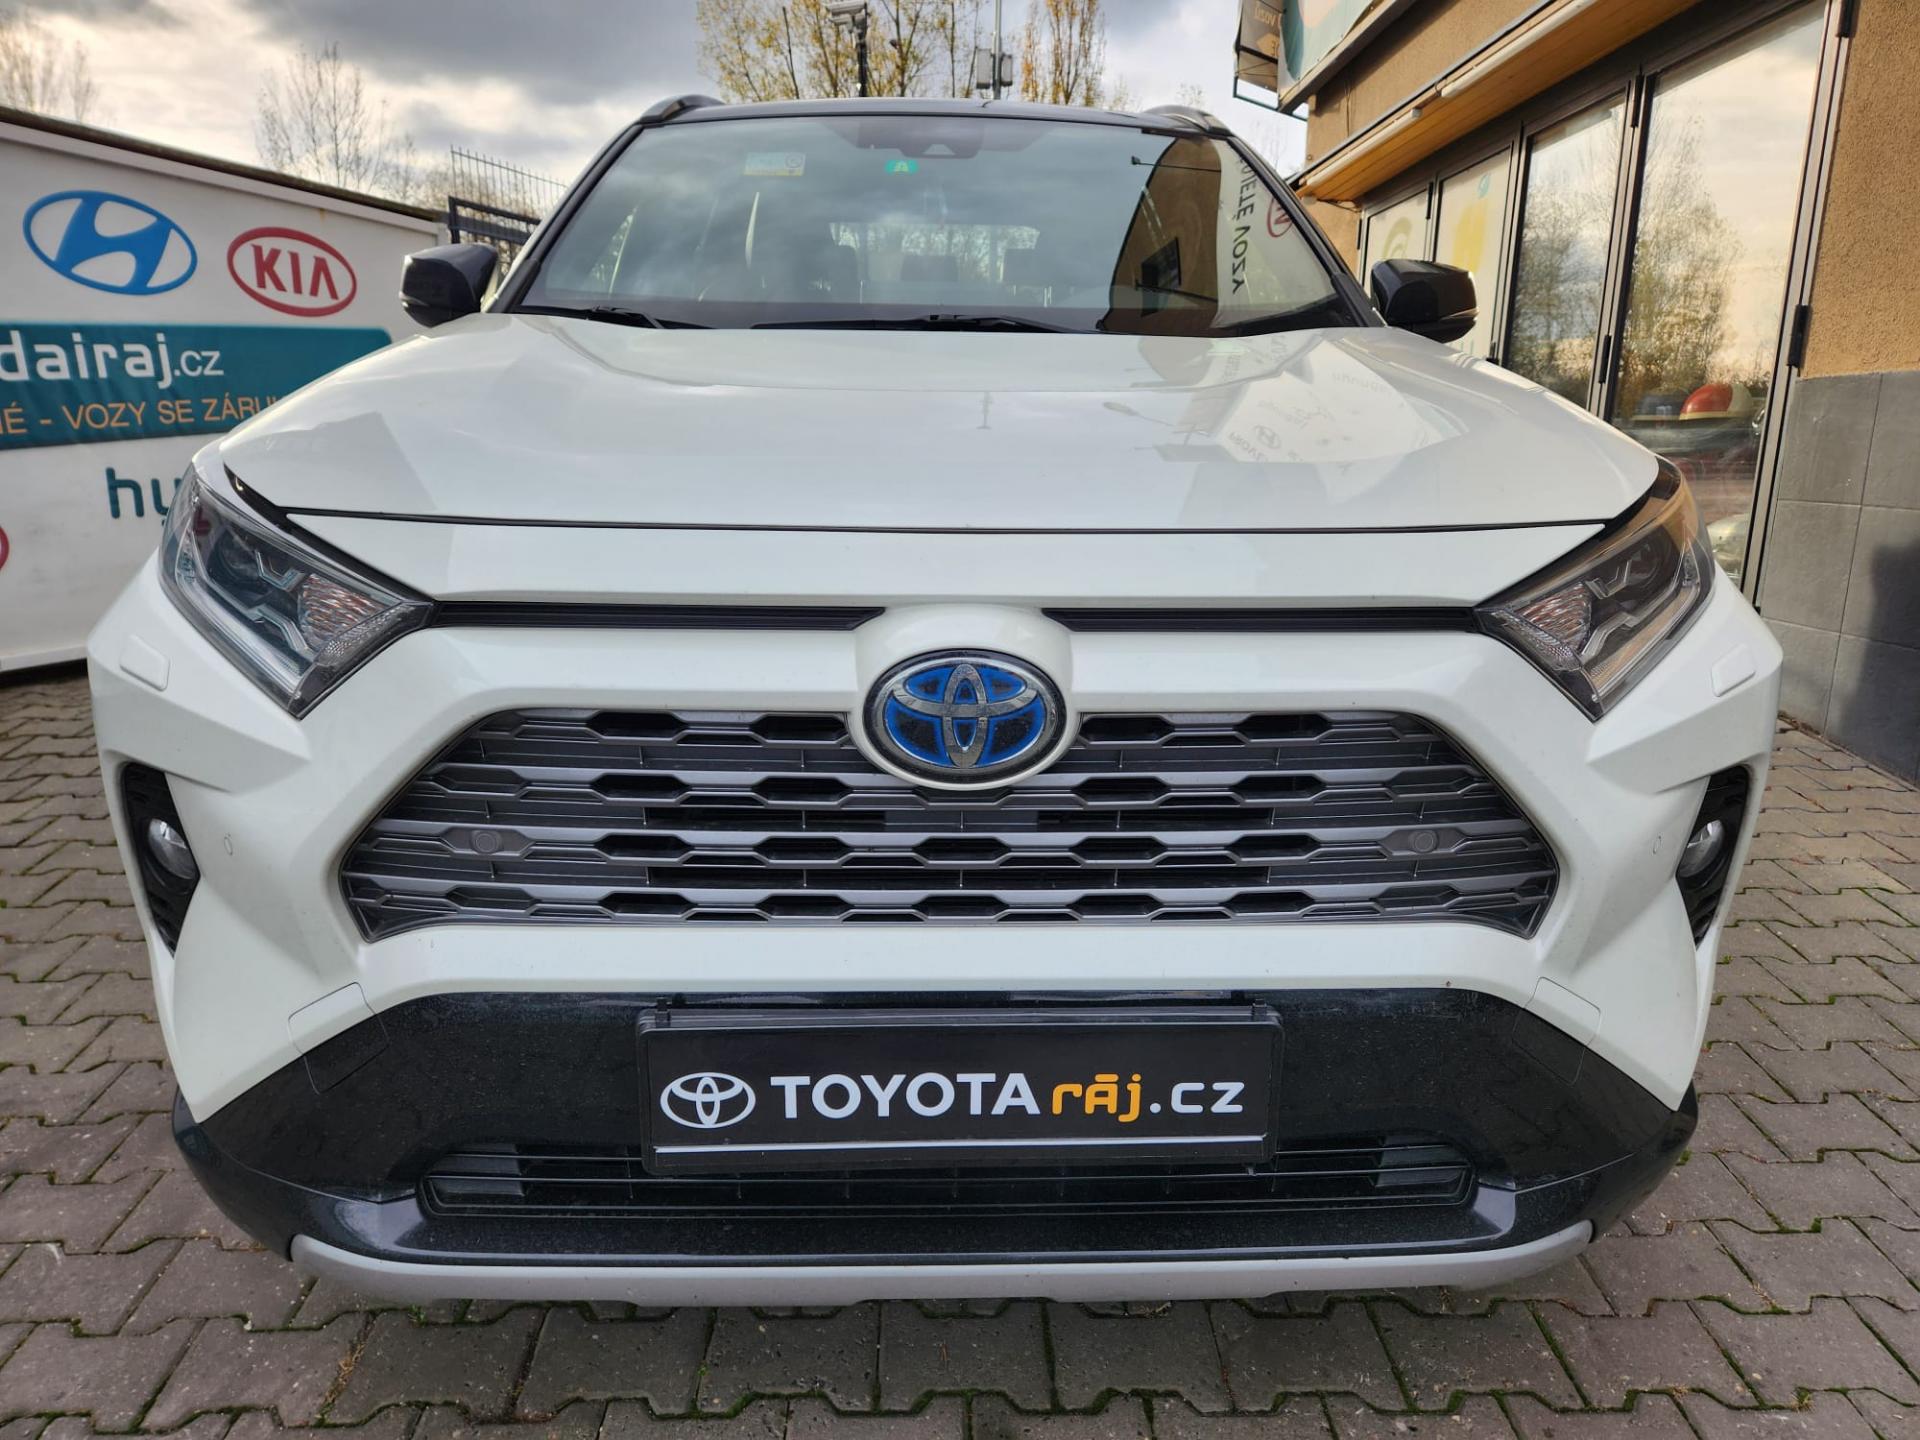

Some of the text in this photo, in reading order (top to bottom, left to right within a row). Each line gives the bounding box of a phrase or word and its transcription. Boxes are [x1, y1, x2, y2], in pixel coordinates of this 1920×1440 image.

[250, 243, 339, 301] KIA
[0, 330, 224, 389] dairaj.cz
[62, 402, 146, 429] VOZY
[157, 399, 194, 424] SE
[202, 391, 277, 420] ZÁR
[770, 1073, 1040, 1120] TOYOTA
